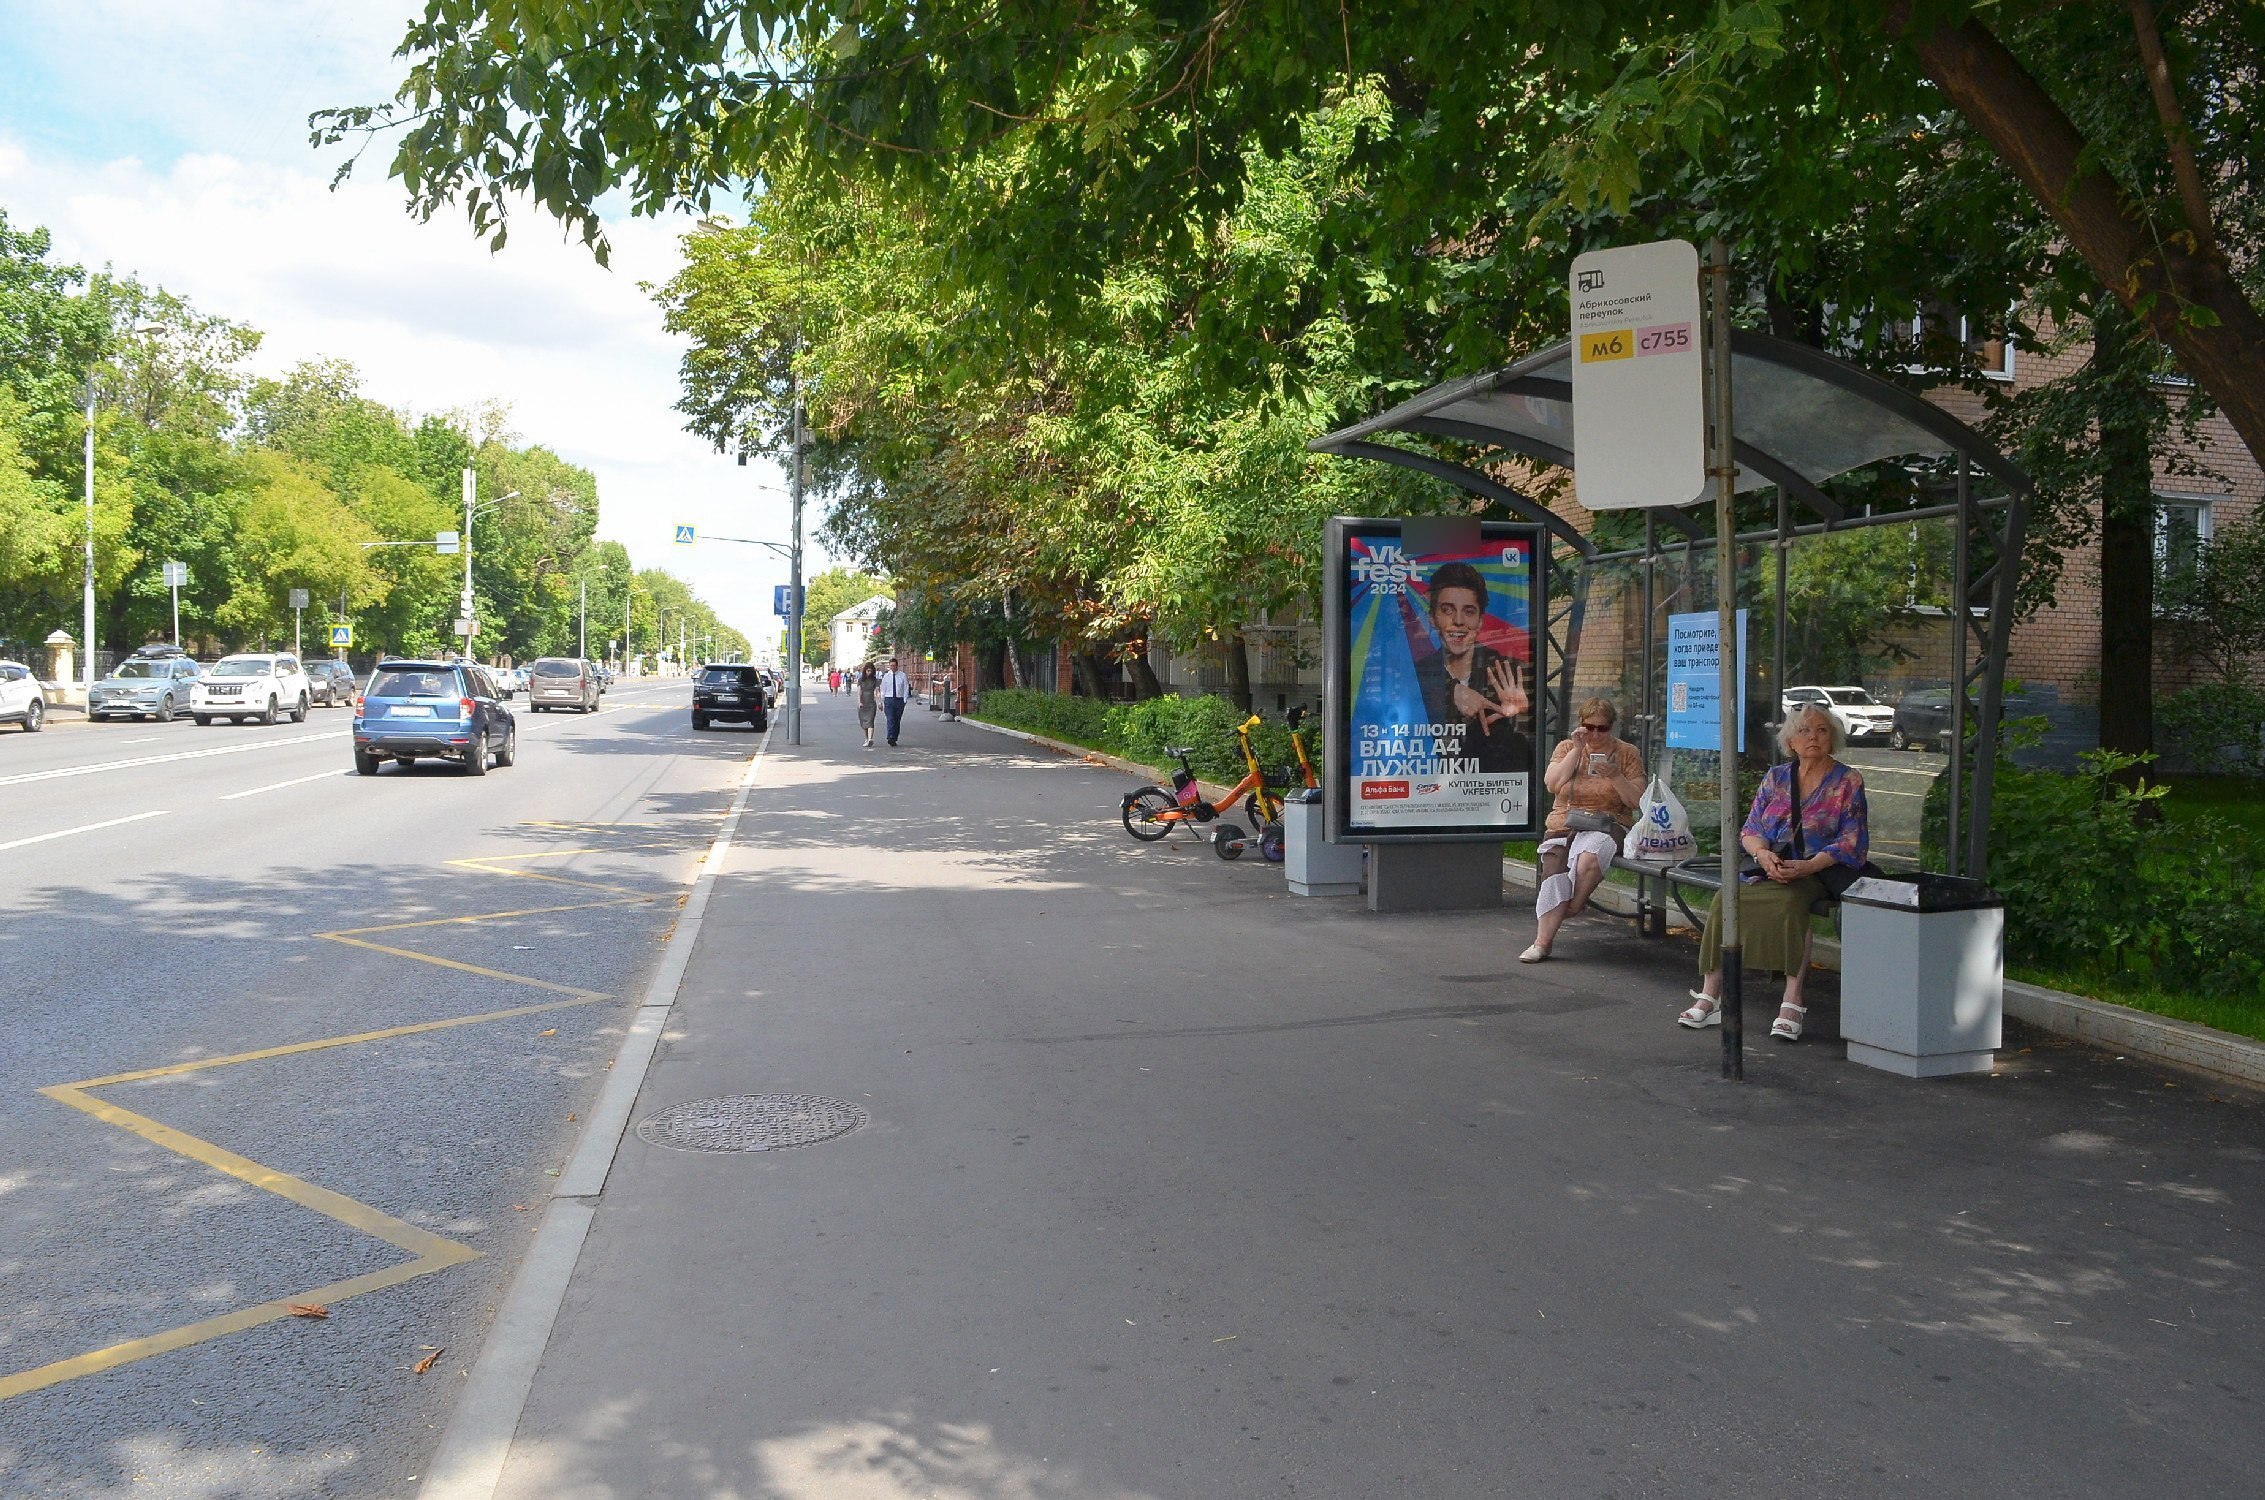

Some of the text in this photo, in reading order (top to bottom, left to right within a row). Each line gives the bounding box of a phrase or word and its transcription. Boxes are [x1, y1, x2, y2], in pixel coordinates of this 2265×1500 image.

[1579, 293, 1652, 310] Абрикосовский
[1580, 308, 1624, 320] переулок
[1368, 545, 1408, 564] VK
[1351, 557, 1428, 582] fest
[1370, 583, 1407, 595] 2024
[1674, 628, 1717, 640] Посмотрите,
[1674, 643, 1719, 654] когда приеде
[1673, 658, 1719, 669] ваш транспор
[1360, 724, 1379, 737] 13
[1391, 724, 1410, 737] 14
[1414, 723, 1467, 736] ИЮЛЯ
[1360, 738, 1461, 758] ВЛАД А4
[1361, 757, 1480, 777] ЛУЖНИКИ
[1448, 779, 1523, 788] КУПИТЬ БИЛЕТЫ
[1365, 785, 1405, 795] Альфа Банк
[1462, 787, 1509, 796] VKFEST.RU
[1500, 798, 1523, 813] 0+
[1639, 835, 1689, 848] лента
